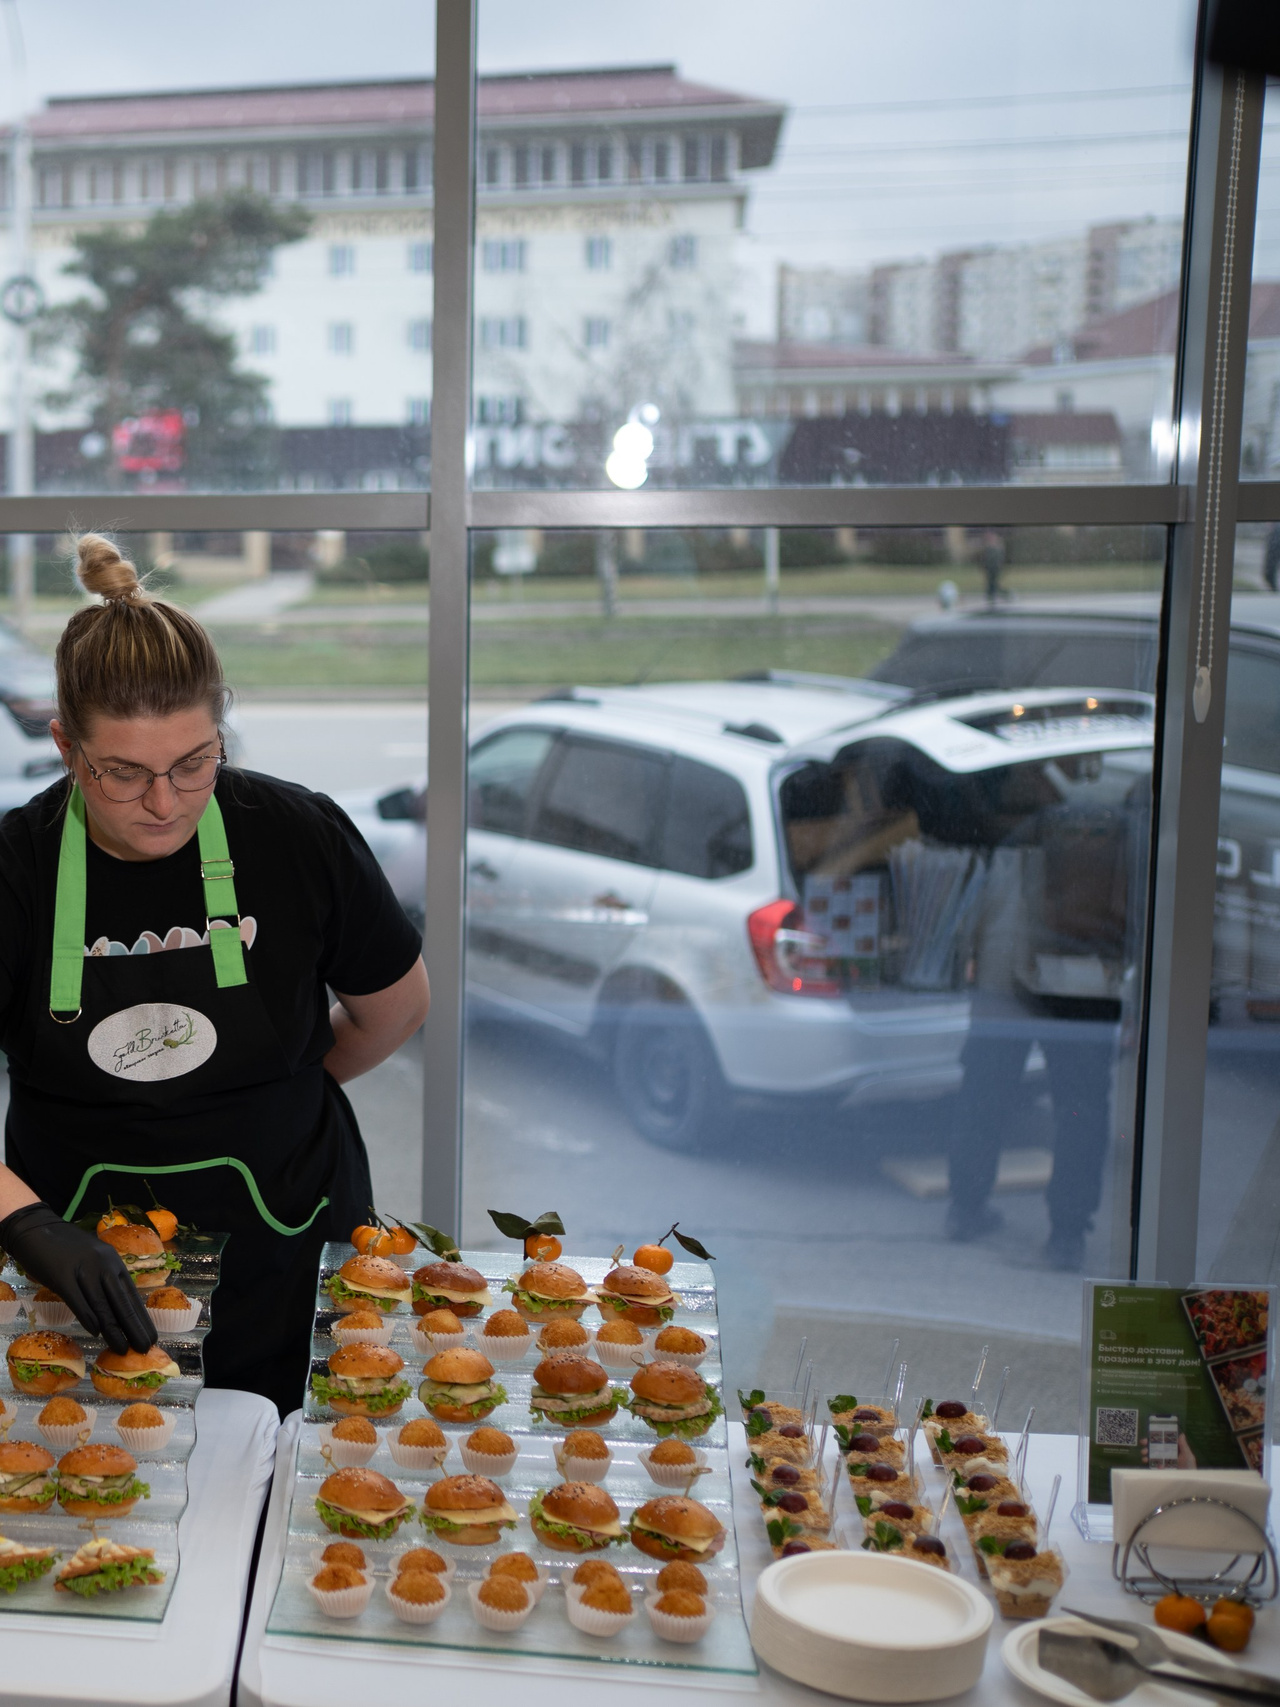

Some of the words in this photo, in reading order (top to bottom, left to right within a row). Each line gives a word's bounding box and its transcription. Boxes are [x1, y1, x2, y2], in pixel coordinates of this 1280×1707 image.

[1098, 1344, 1135, 1355] Быстро
[1136, 1347, 1184, 1356] доставим
[1098, 1355, 1145, 1364] праздник
[1178, 1359, 1201, 1367] дом!
